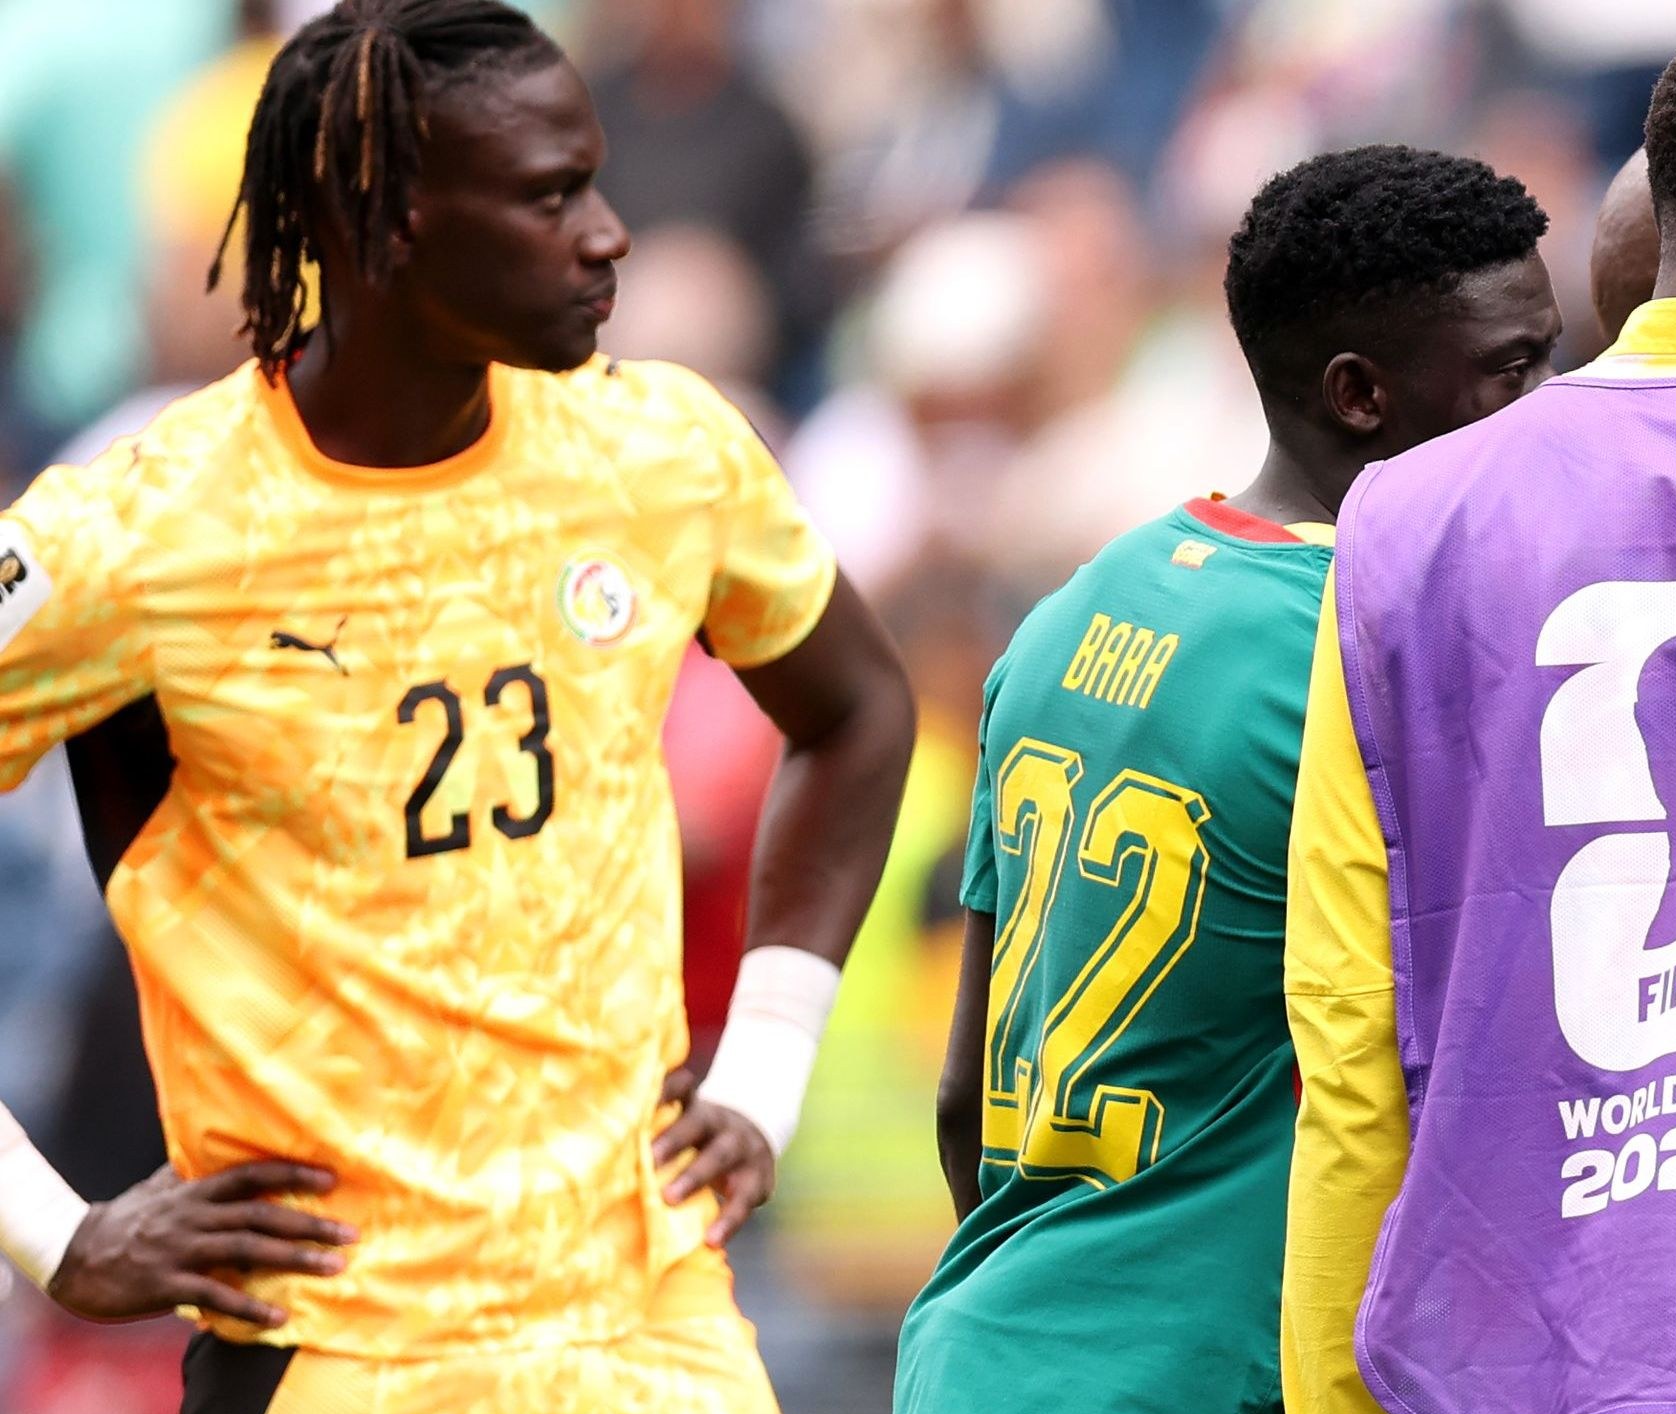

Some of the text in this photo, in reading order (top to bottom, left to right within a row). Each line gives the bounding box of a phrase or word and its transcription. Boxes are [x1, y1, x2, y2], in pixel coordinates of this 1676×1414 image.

[1062, 613, 1179, 709] BARA
[398, 663, 555, 859] 23
[981, 737, 1212, 1190] 22
